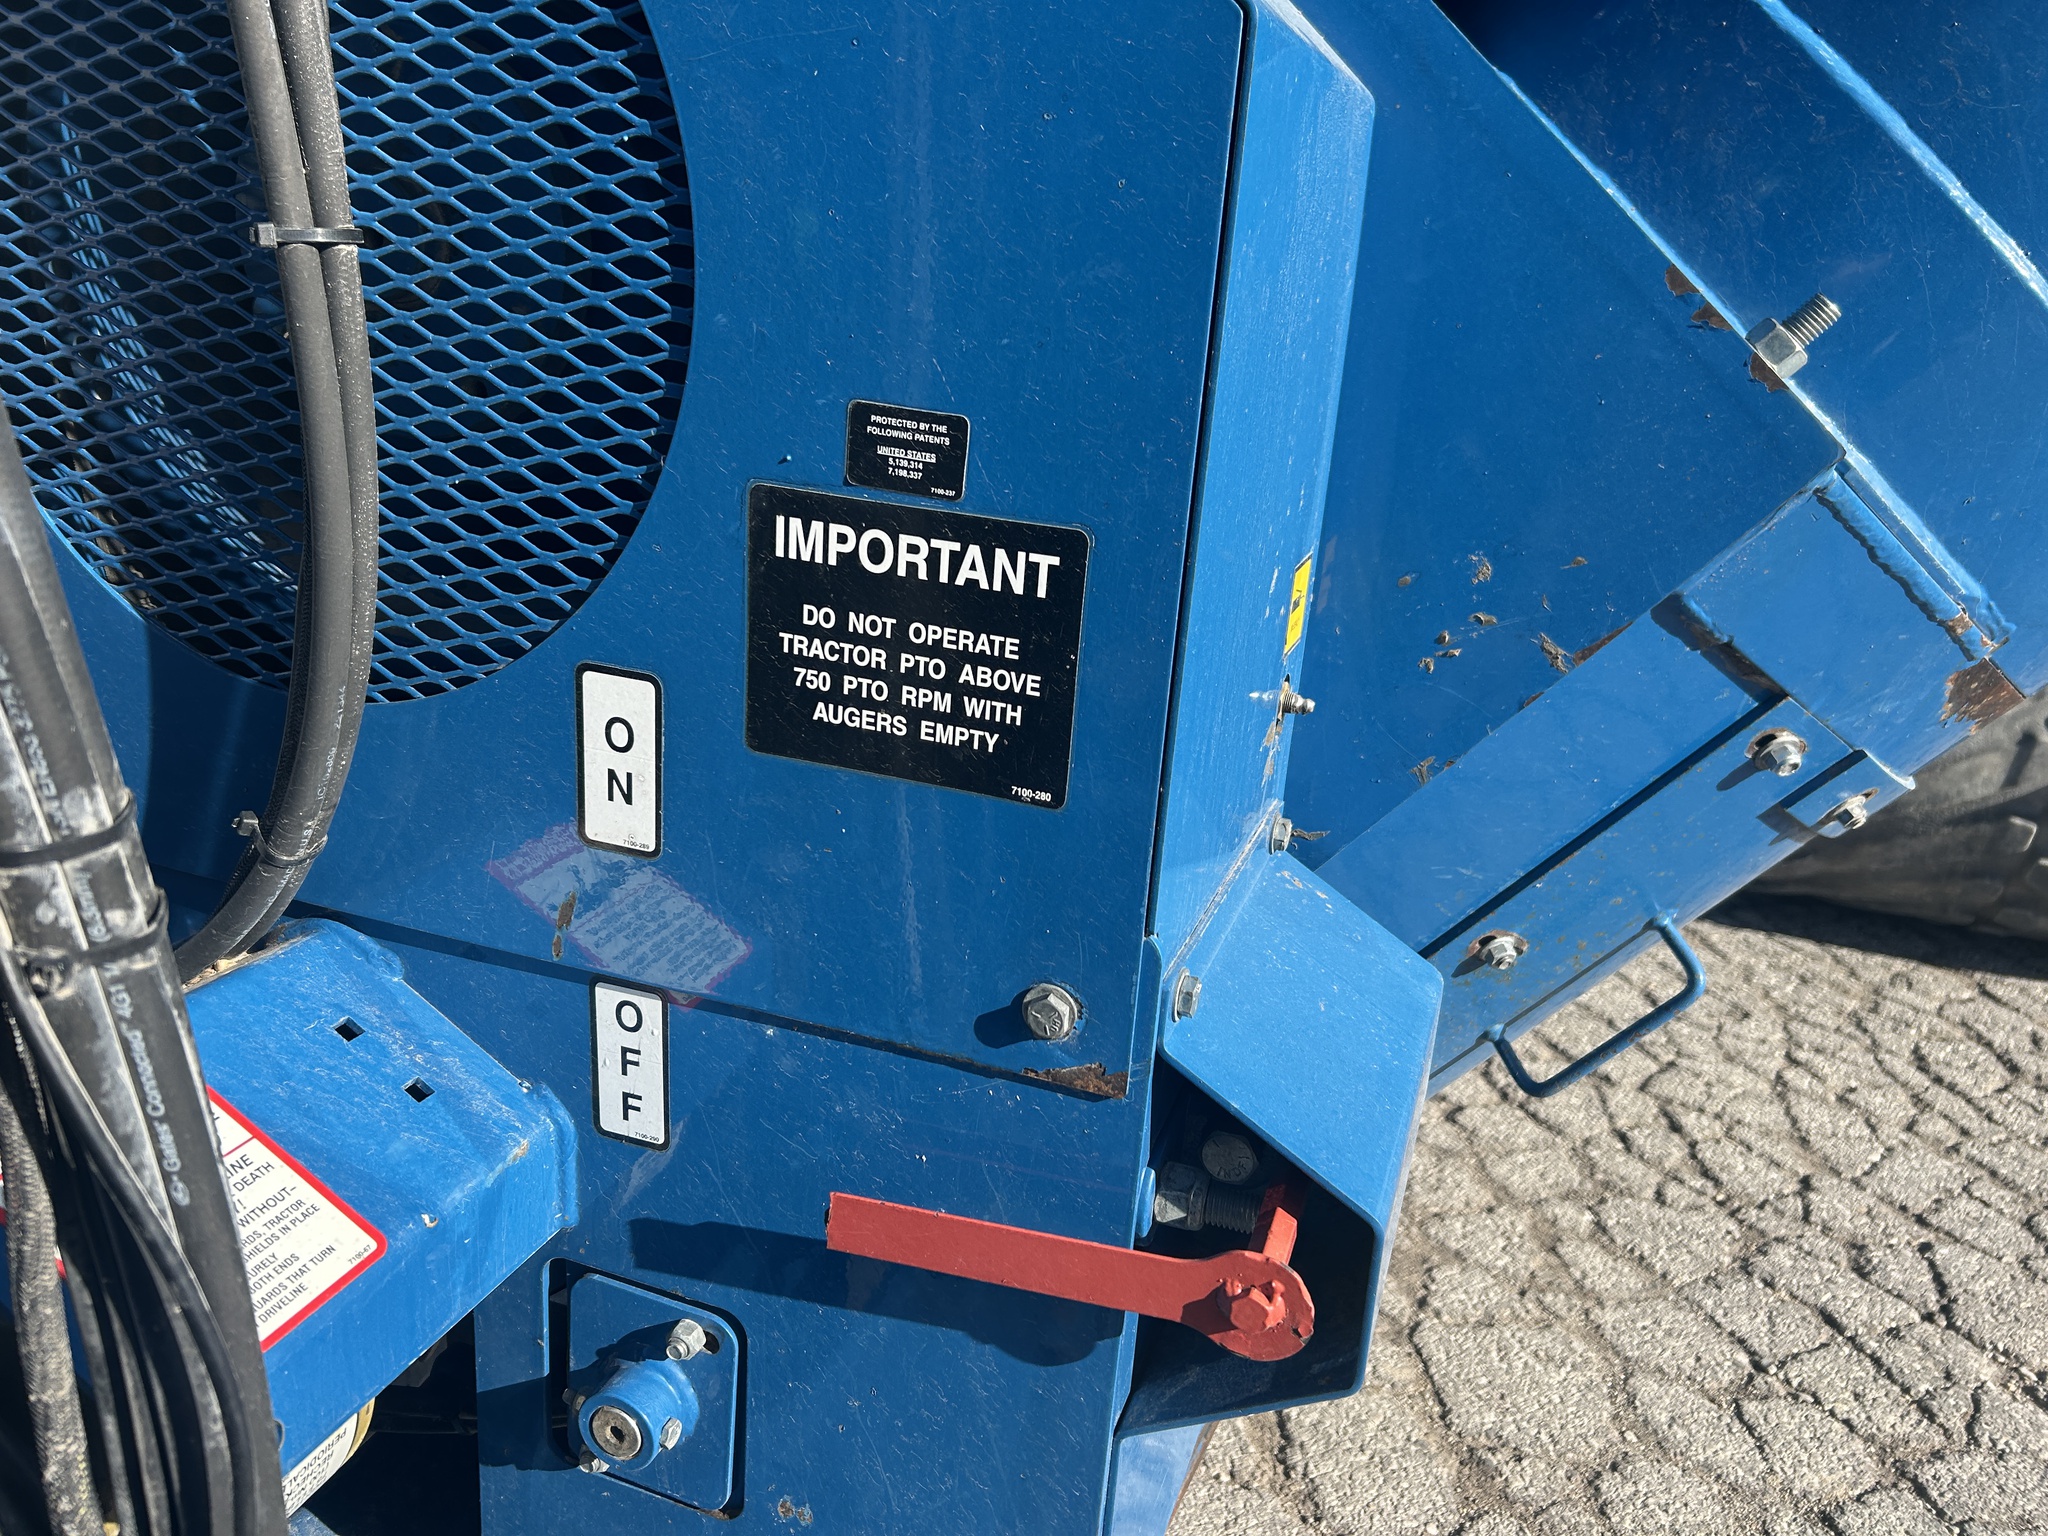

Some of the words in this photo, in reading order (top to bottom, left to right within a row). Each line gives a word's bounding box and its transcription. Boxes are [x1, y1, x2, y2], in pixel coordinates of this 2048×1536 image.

[866, 425, 913, 440] FOLLOWING
[914, 433, 950, 446] PATENTS
[870, 414, 918, 429] PROTECTED
[919, 422, 930, 431] BY
[931, 424, 948, 434] THE
[876, 445, 905, 457] UNITED
[906, 450, 937, 462] STATES
[888, 457, 923, 470] 5,139,314
[888, 467, 923, 480] 7,198,337
[930, 487, 956, 497] 7100-237
[774, 514, 1061, 599] IMPORTANT
[802, 603, 836, 629] DO
[848, 611, 897, 639] NOT
[908, 622, 1020, 661] OPERATE
[778, 632, 887, 671] TRACTOR
[900, 653, 946, 680] PTO
[958, 664, 1042, 697] ABOVE
[793, 667, 831, 692] 750
[843, 676, 889, 702] PTO
[901, 685, 953, 714] RPM
[963, 696, 1023, 727] WITH
[812, 702, 908, 736] AUGERS
[919, 720, 1000, 754] EMPTY
[604, 716, 635, 806] ON
[1011, 786, 1052, 802] 7100-280
[622, 838, 650, 851] 7100-289
[615, 1000, 643, 1122] OFF
[634, 1131, 660, 1143] 7100-290
[225, 1153, 254, 1179] INE
[233, 1161, 275, 1192] DEATH
[241, 1230, 266, 1249] RDS,
[262, 1198, 307, 1231] TRACTOR
[279, 1224, 292, 1240] IN
[289, 1203, 321, 1233] PLACE
[247, 1252, 279, 1280] URELY
[252, 1282, 288, 1312] UARDS
[285, 1263, 310, 1284] THAT
[308, 1245, 336, 1271] TURN
[272, 1252, 300, 1275] ENDS
[258, 1282, 309, 1323] DRIVELINE
[286, 1449, 335, 1496] RECHECK
